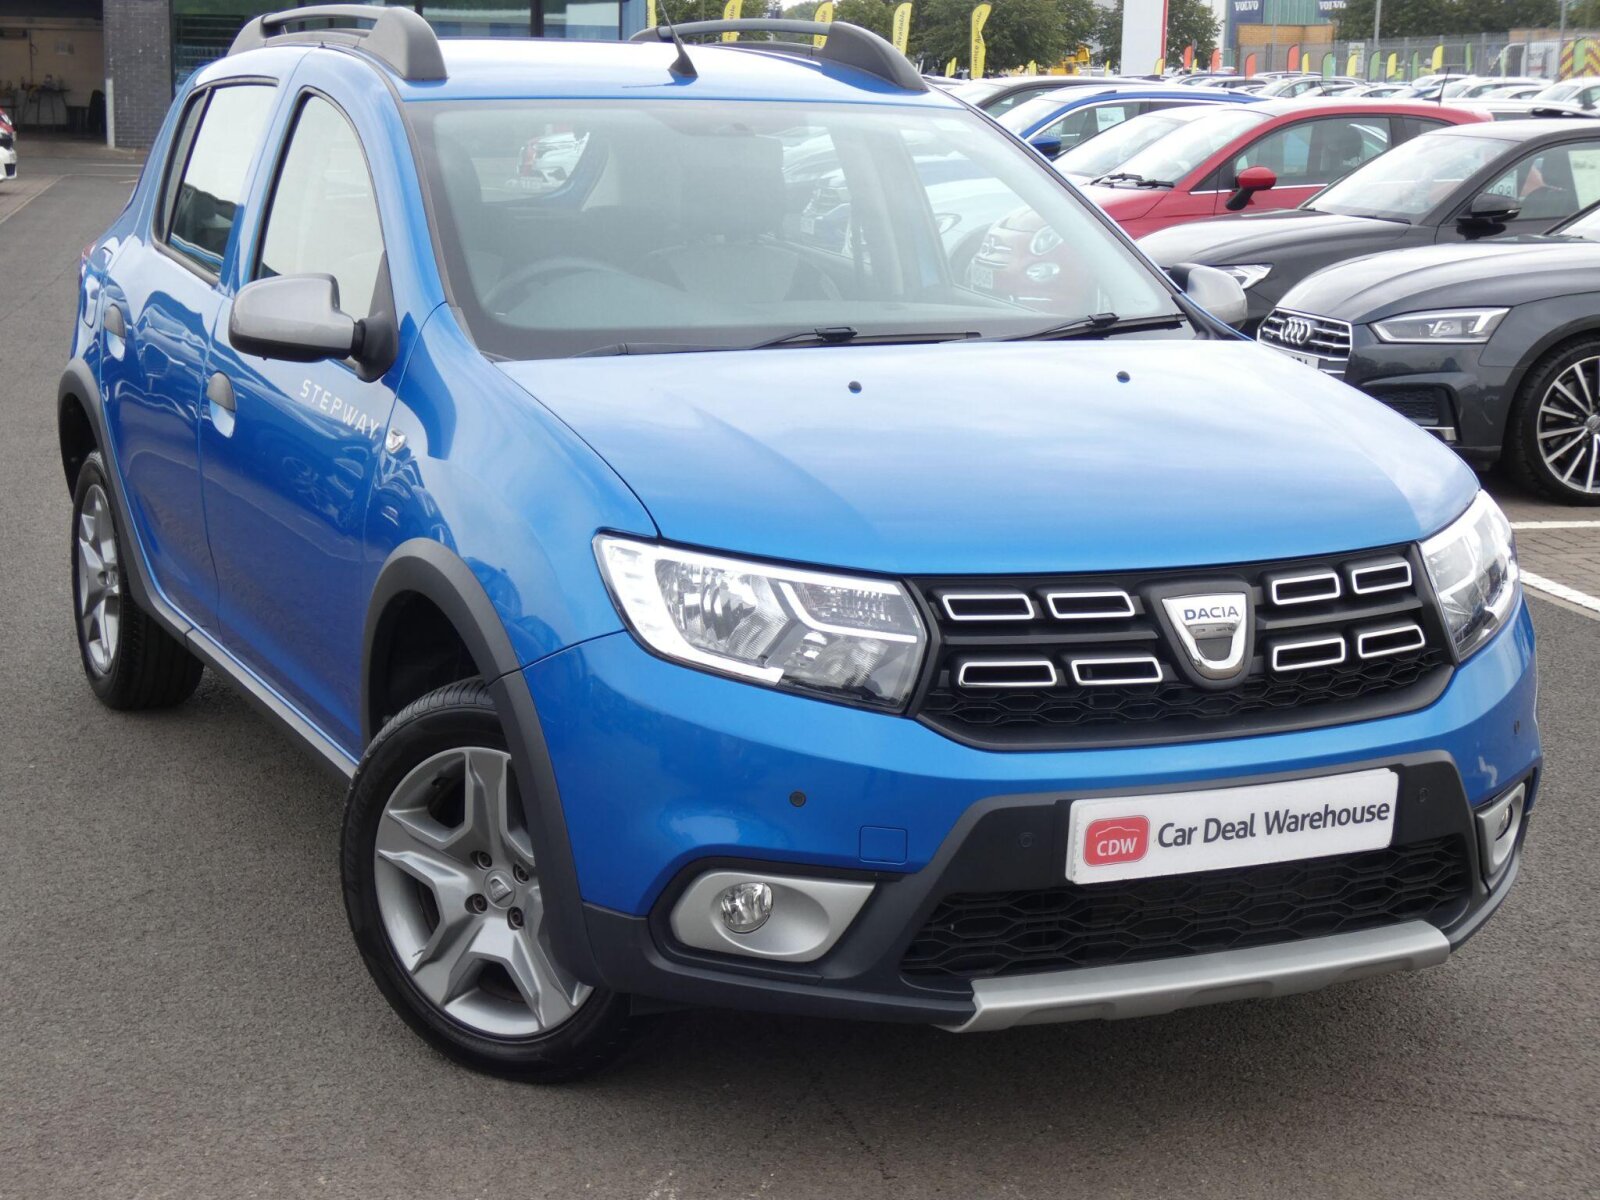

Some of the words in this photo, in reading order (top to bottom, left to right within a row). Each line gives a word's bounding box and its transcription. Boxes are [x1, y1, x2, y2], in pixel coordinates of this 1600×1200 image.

[1235, 1, 1259, 11] VOLVO
[300, 379, 380, 440] STEPWAY
[1183, 605, 1239, 620] DACIA
[1157, 822, 1198, 848] Car
[1203, 813, 1256, 843] Deal
[1264, 803, 1390, 835] Warehouse
[1096, 837, 1138, 857] CDW
